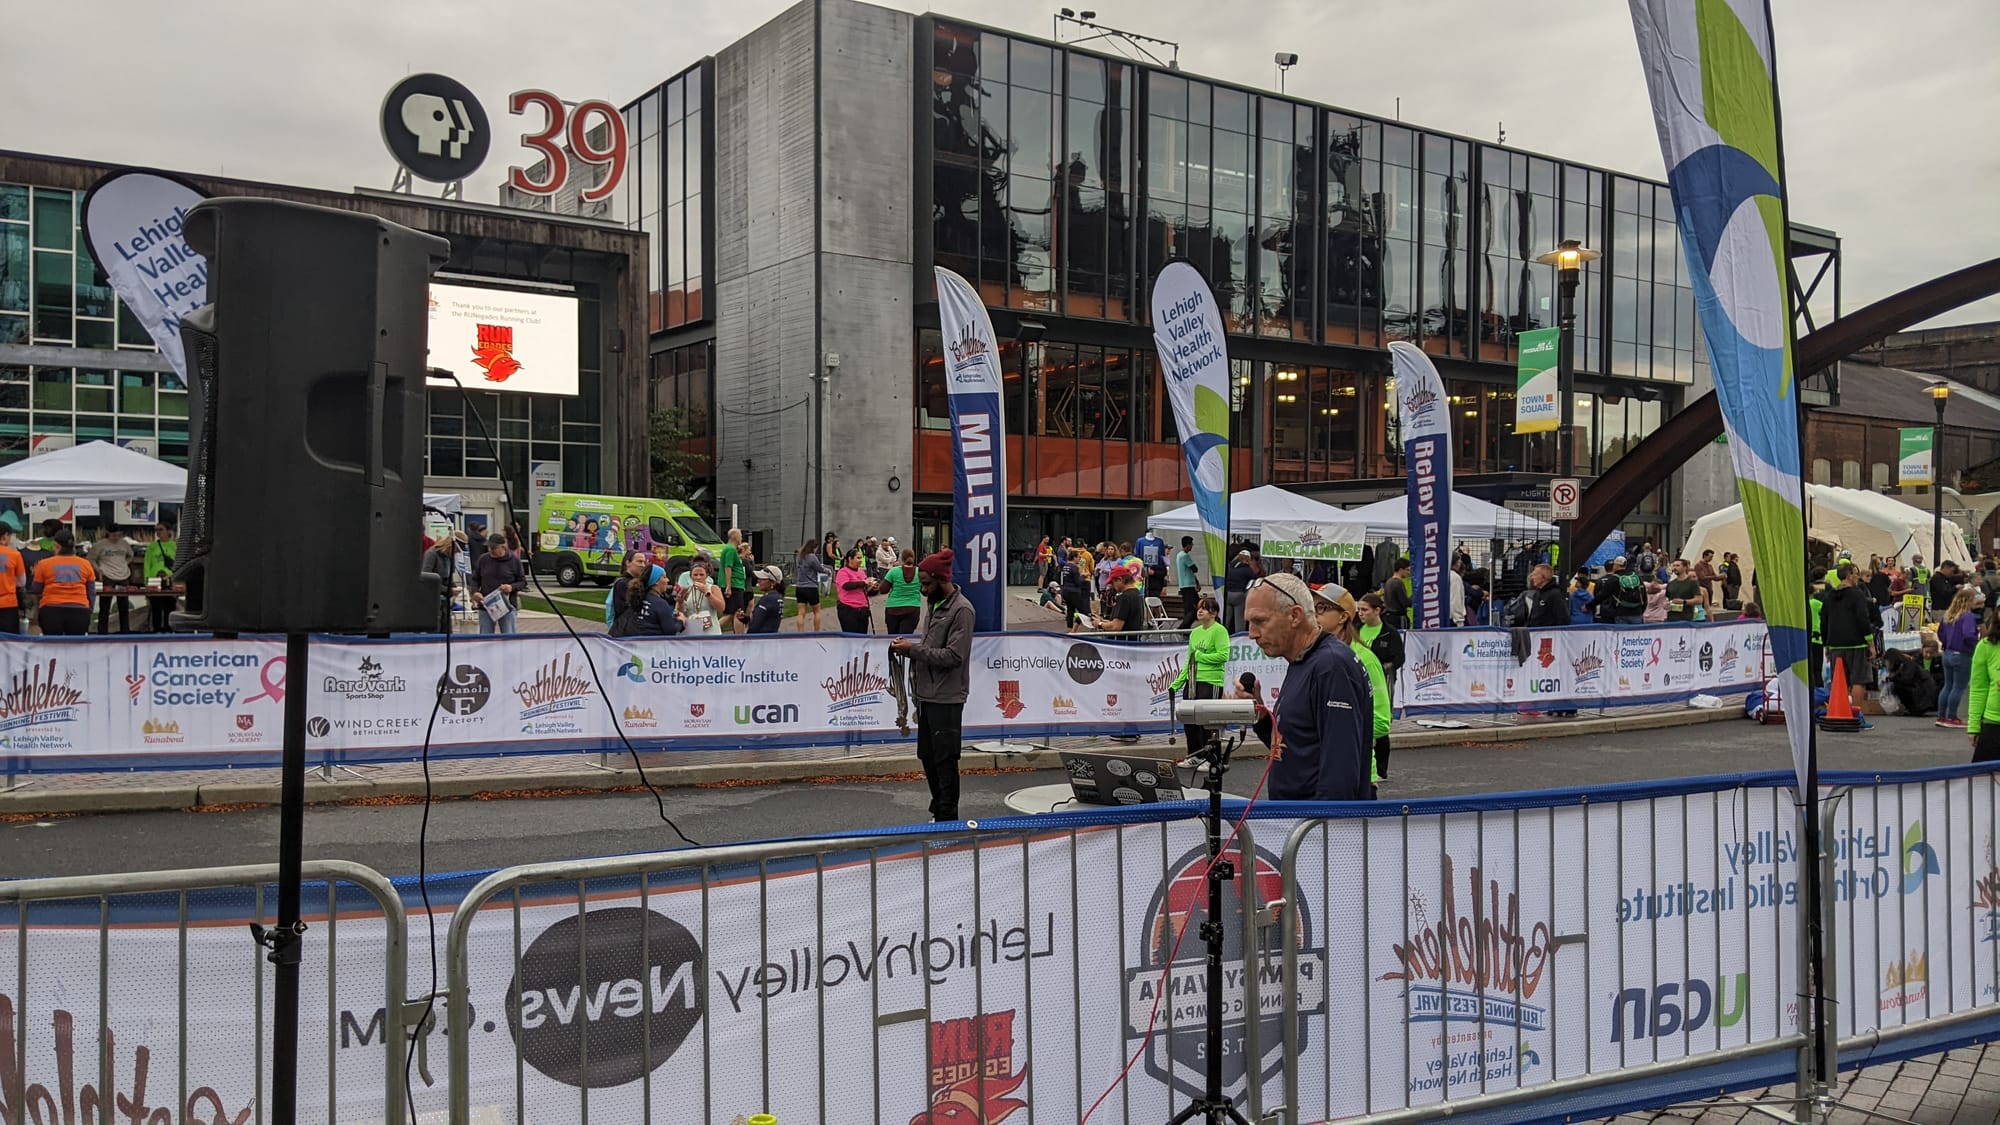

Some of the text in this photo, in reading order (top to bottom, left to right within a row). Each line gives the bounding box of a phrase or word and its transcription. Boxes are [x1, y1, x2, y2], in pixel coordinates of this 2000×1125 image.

[509, 89, 628, 202] 39
[137, 242, 200, 279] Valle
[1162, 290, 1203, 325] Lehigh
[500, 315, 524, 323] Running
[1168, 313, 1205, 341] Valley
[478, 324, 513, 343] RUN
[1172, 329, 1212, 363] Health
[1171, 345, 1222, 384] Network
[1521, 394, 1544, 404] TOWN
[1521, 403, 1552, 414] SQUARE
[958, 413, 994, 519] MILE
[1415, 440, 1435, 517] Relay
[966, 532, 998, 583] 13
[1262, 540, 1362, 560] MERCHANDISE
[1422, 521, 1441, 630] Exchang
[1477, 639, 1499, 649] Lehigh
[1622, 636, 1652, 646] American
[152, 651, 259, 668] American
[1477, 649, 1498, 657] Health
[1621, 648, 1644, 657] Cancer
[651, 655, 746, 672] Lehigh Valley
[1621, 659, 1644, 669] Society
[152, 670, 233, 687] Cancer
[323, 675, 406, 693] Aardvark
[513, 652, 598, 708] Bethlehem
[651, 670, 799, 687] Orthopedic Institute
[821, 651, 888, 702] Bethlehem
[1530, 678, 1560, 693] ucan
[153, 688, 236, 708] Society
[441, 716, 485, 725] Factory
[734, 704, 799, 724] ucan
[334, 717, 418, 729] WIND CREEK
[557, 721, 575, 729] Valley
[13, 735, 40, 743] Lehigh
[40, 741, 73, 749] Network
